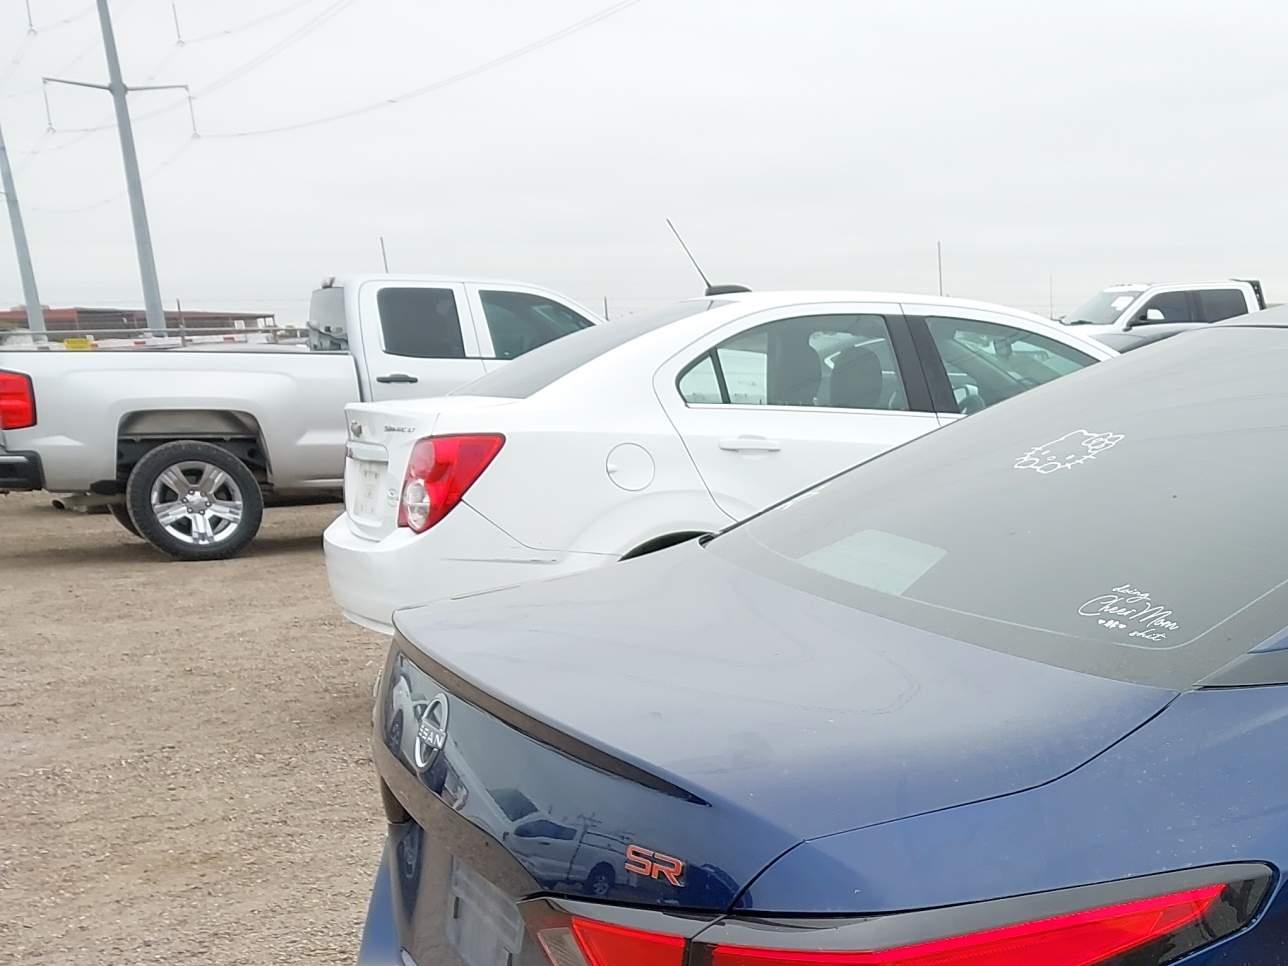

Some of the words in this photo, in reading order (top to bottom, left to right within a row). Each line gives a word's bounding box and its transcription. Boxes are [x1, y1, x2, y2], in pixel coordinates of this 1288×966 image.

[1078, 594, 1137, 616] Cheer
[1128, 601, 1180, 631] Mom
[1128, 627, 1167, 641] shit
[623, 844, 685, 888] SR
